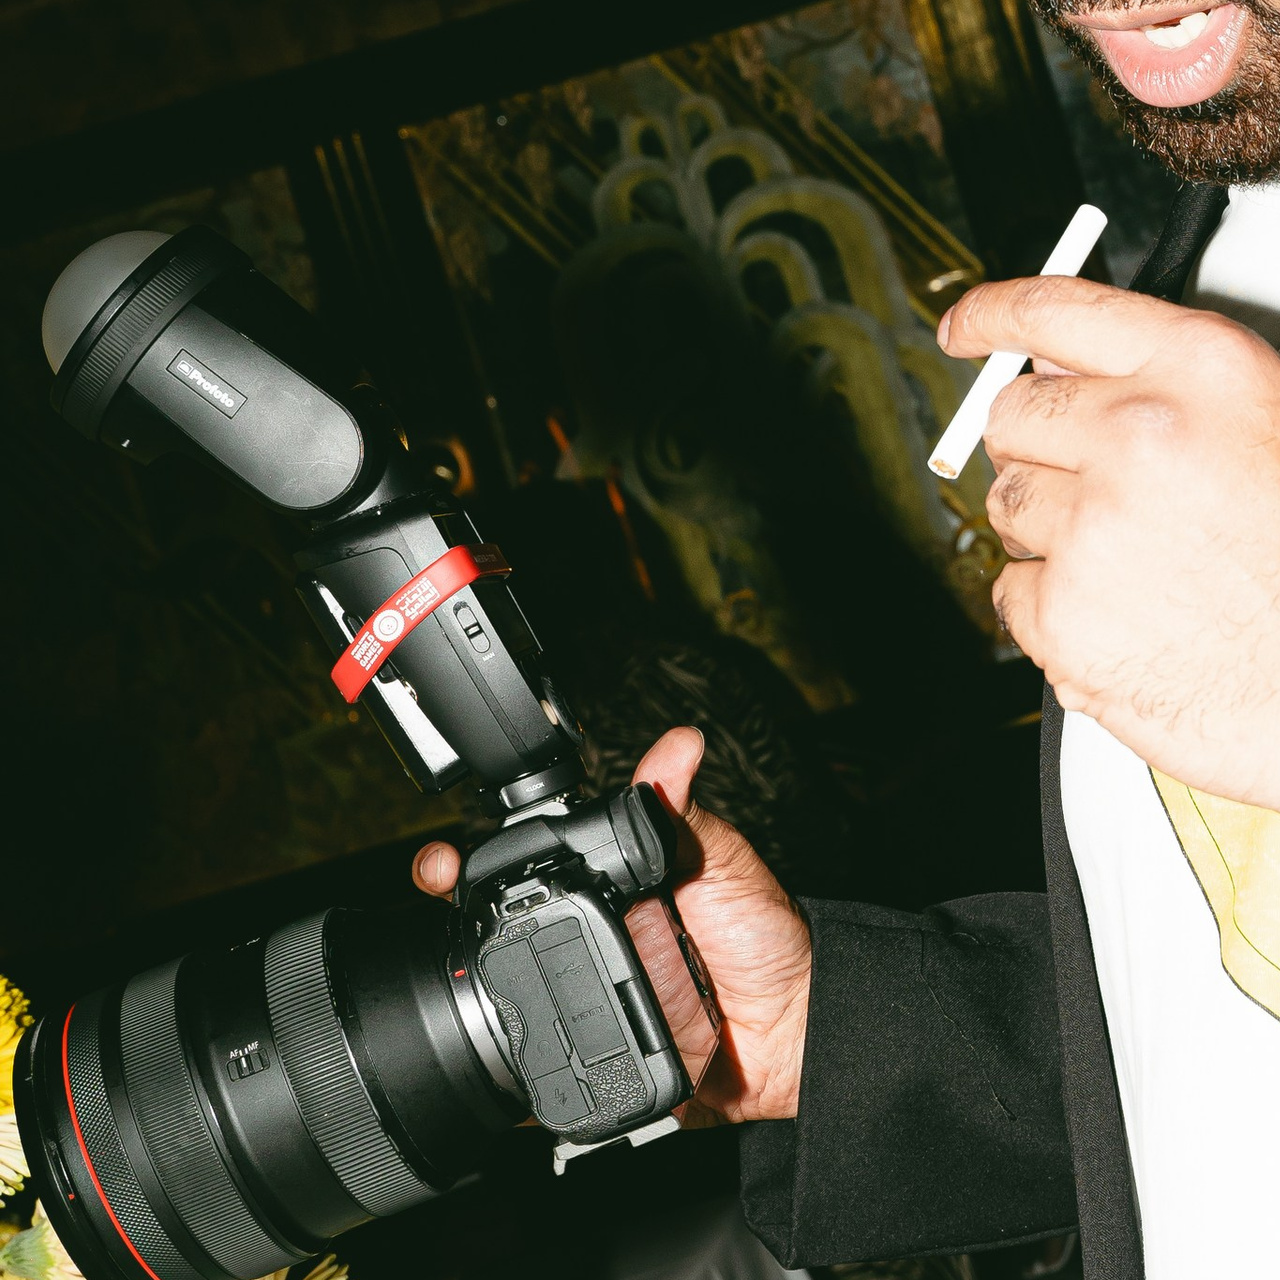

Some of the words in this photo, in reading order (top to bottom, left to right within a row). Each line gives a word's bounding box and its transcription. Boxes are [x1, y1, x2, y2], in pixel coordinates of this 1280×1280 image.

[188, 369, 234, 408] Profoto
[353, 634, 375, 661] WORLD
[359, 640, 381, 667] GAMES
[229, 1048, 239, 1059] AF
[247, 1041, 260, 1052] MF
